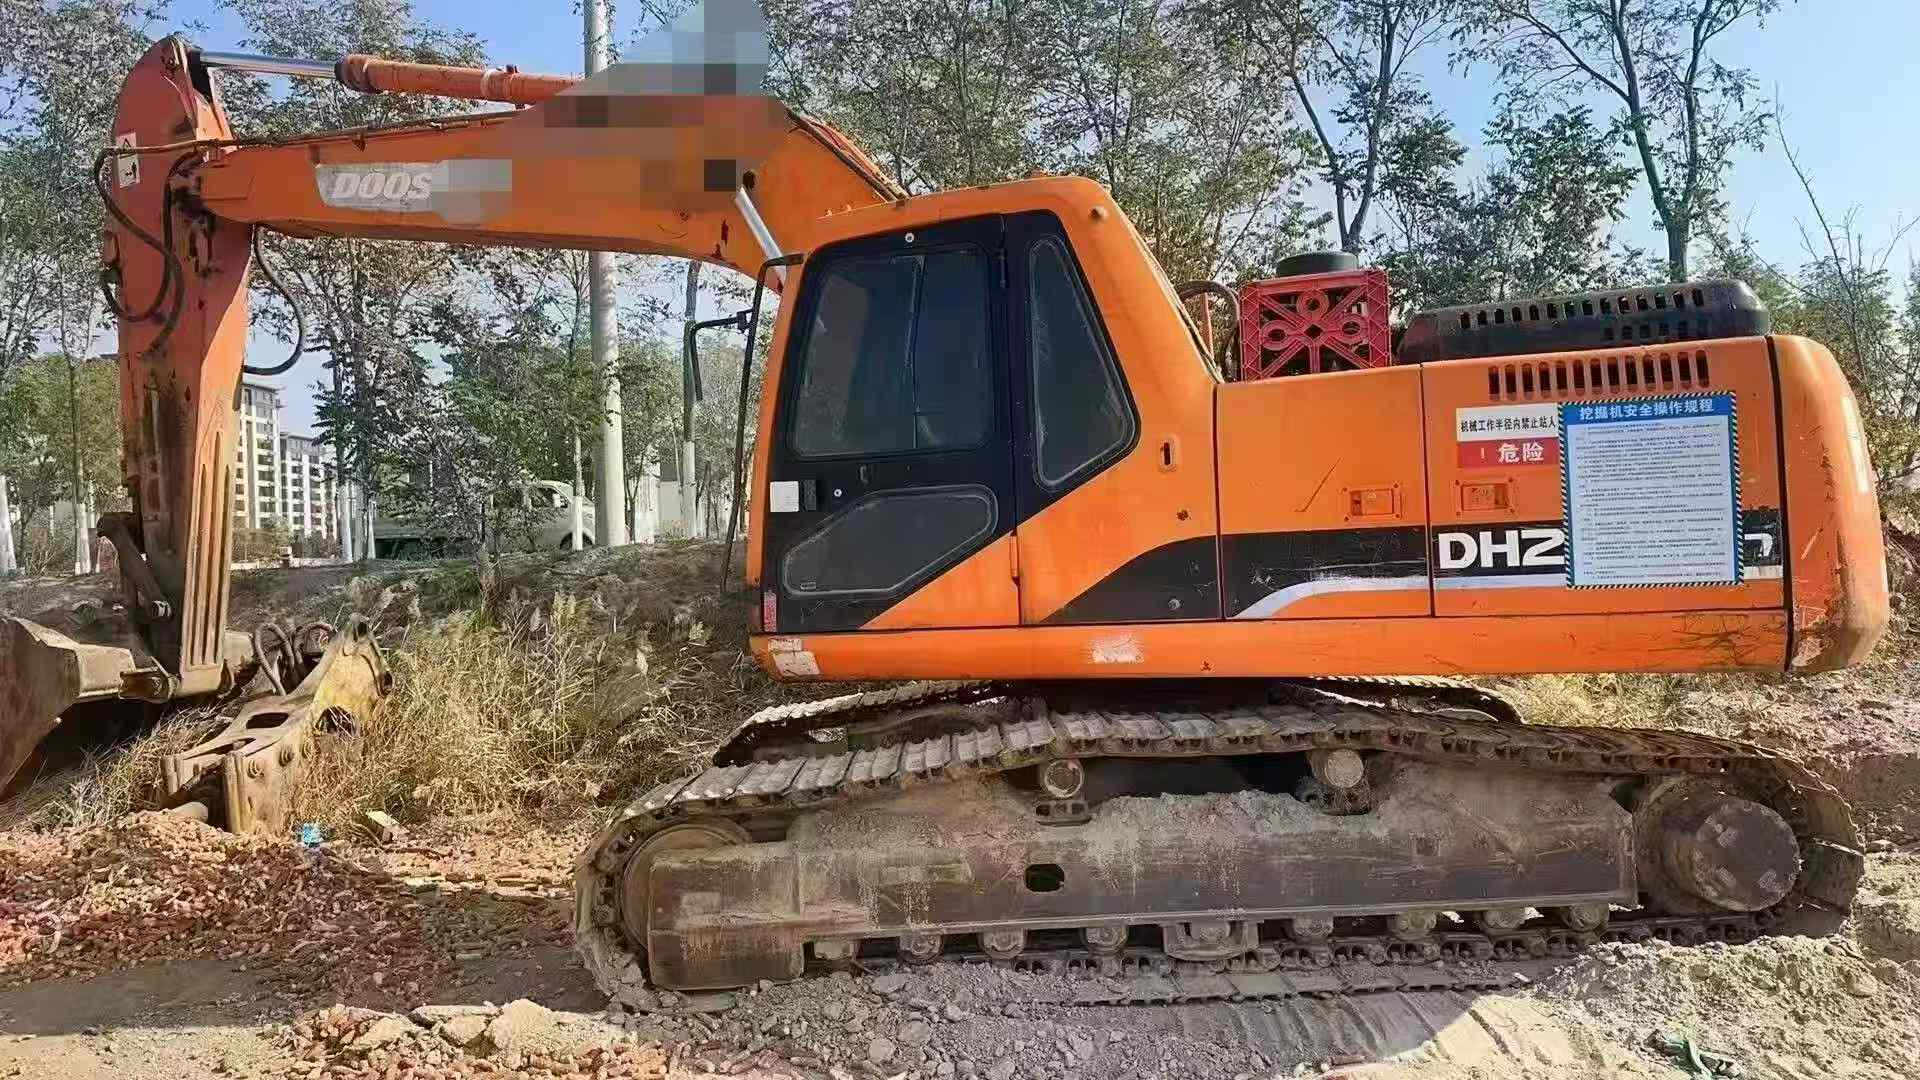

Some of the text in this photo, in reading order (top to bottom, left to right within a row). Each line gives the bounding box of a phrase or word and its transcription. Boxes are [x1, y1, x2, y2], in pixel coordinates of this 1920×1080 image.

[331, 170, 433, 200] DOOS
[1579, 399, 1714, 421] 挖掘机安全操作规程
[1460, 415, 1556, 433] 机械工作半径内禁止站人
[1498, 441, 1545, 464] 危险
